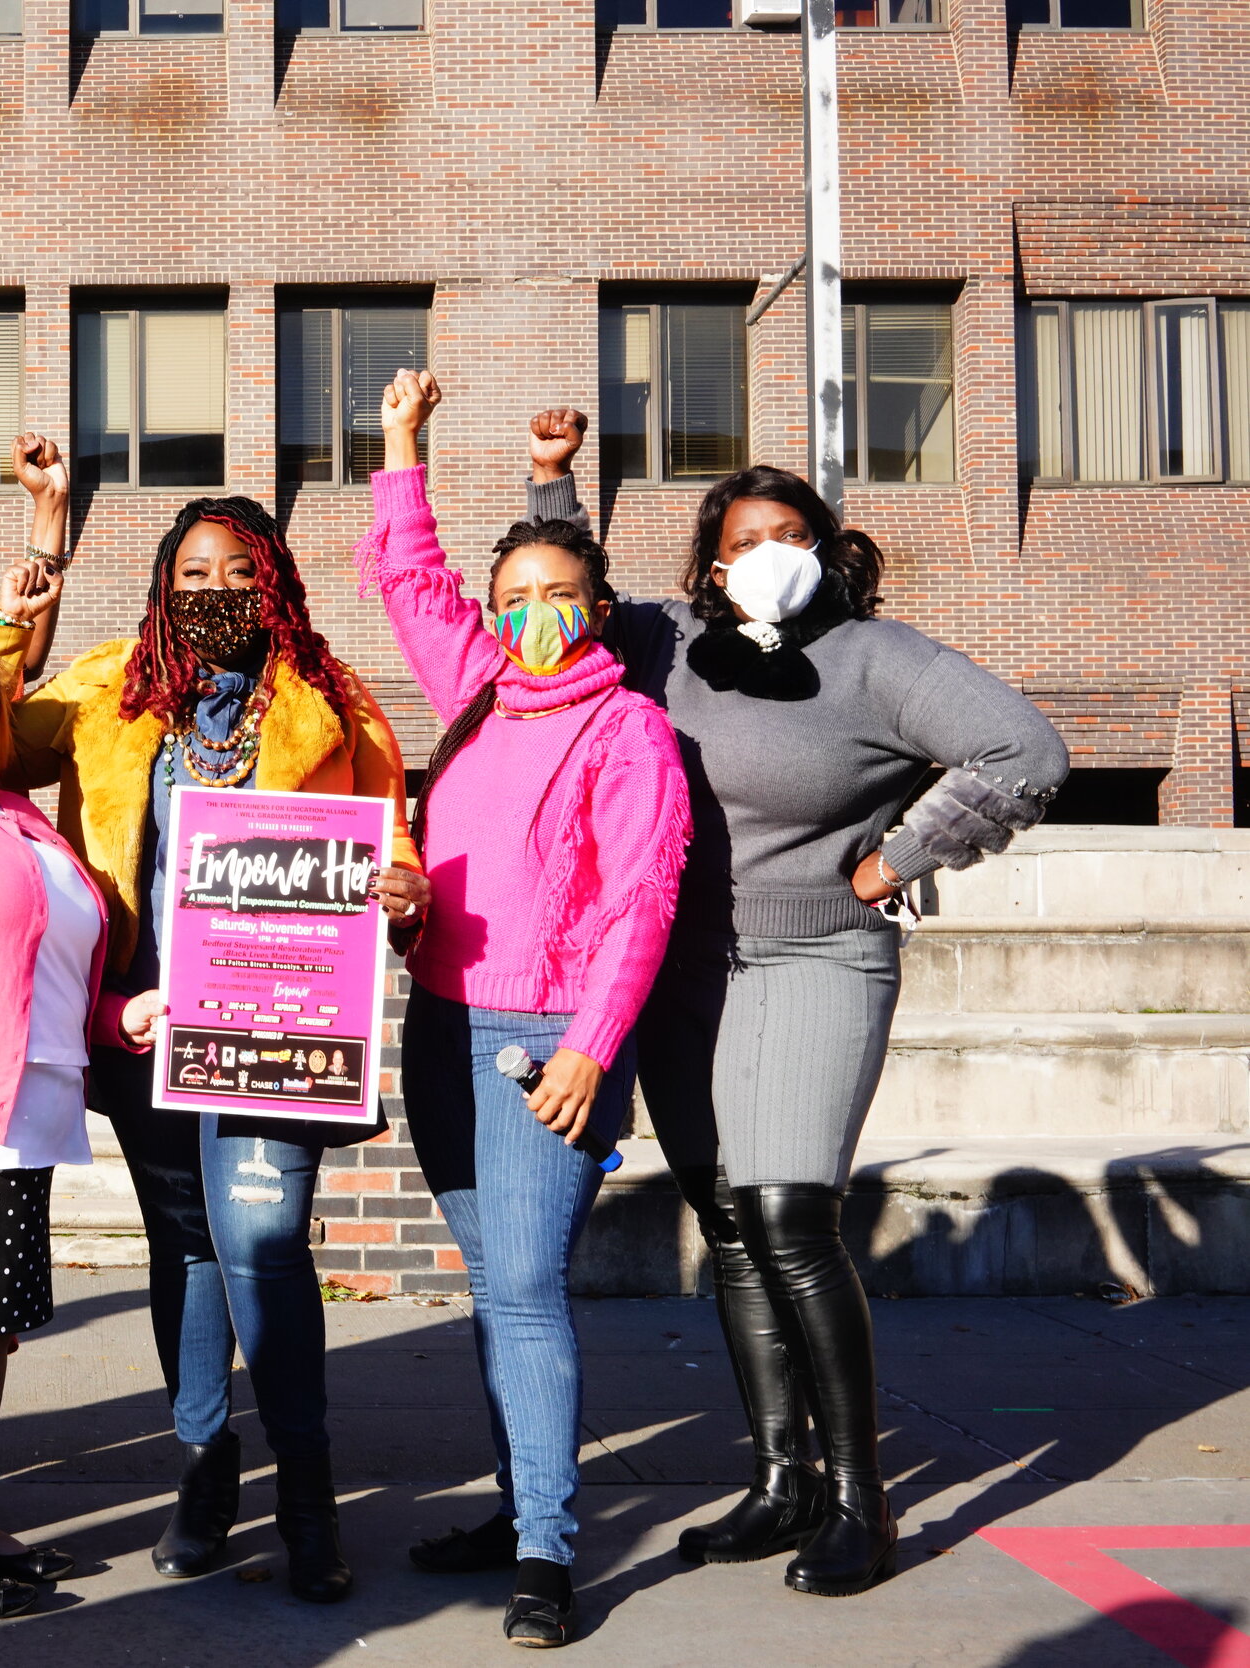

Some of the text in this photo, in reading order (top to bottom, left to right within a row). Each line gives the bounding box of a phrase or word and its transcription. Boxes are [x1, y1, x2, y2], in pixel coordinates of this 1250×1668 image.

[220, 802, 270, 810] ENTERTAINERS
[286, 805, 324, 814] EDUCATION
[325, 808, 358, 816] ALLIANCE
[257, 812, 292, 821] GRADUATE
[185, 831, 376, 912] Empower Her
[196, 894, 232, 904] Women's
[240, 896, 297, 908] Empowerment
[299, 901, 344, 912] Community
[345, 903, 368, 913] Event
[210, 918, 338, 937] Saturday, November 14th
[202, 939, 345, 955] Bedford Stuyvesant Restoration Plaza
[298, 955, 322, 963] Mural)
[273, 982, 310, 1002] Empower
[251, 1030, 276, 1040] SPONSORED
[251, 1080, 273, 1089] CHASE
